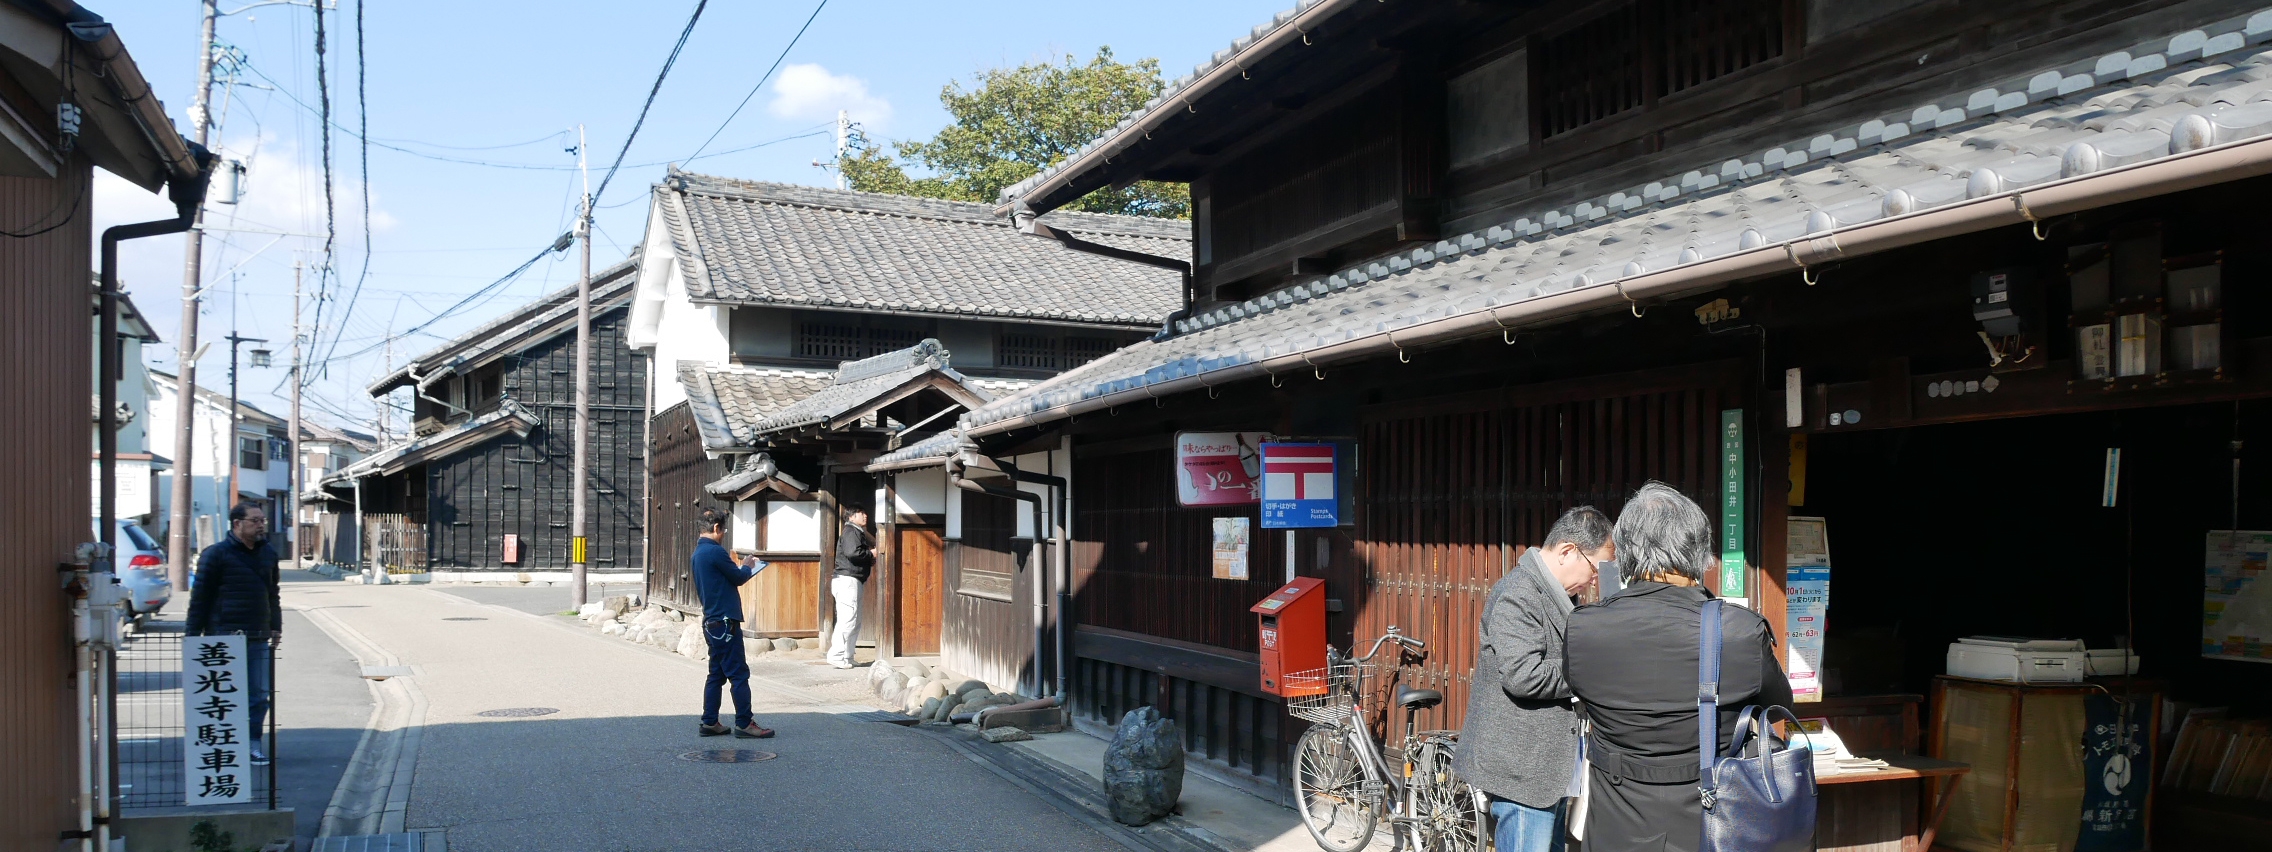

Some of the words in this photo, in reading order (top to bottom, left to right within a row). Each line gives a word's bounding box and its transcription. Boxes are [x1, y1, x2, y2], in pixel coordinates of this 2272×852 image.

[1265, 502, 1297, 510] 切手・はがき
[1728, 452, 1737, 550] 中小田井一丁目
[1805, 629, 1819, 637] 63円
[192, 641, 242, 799] 善光寺駐車場
